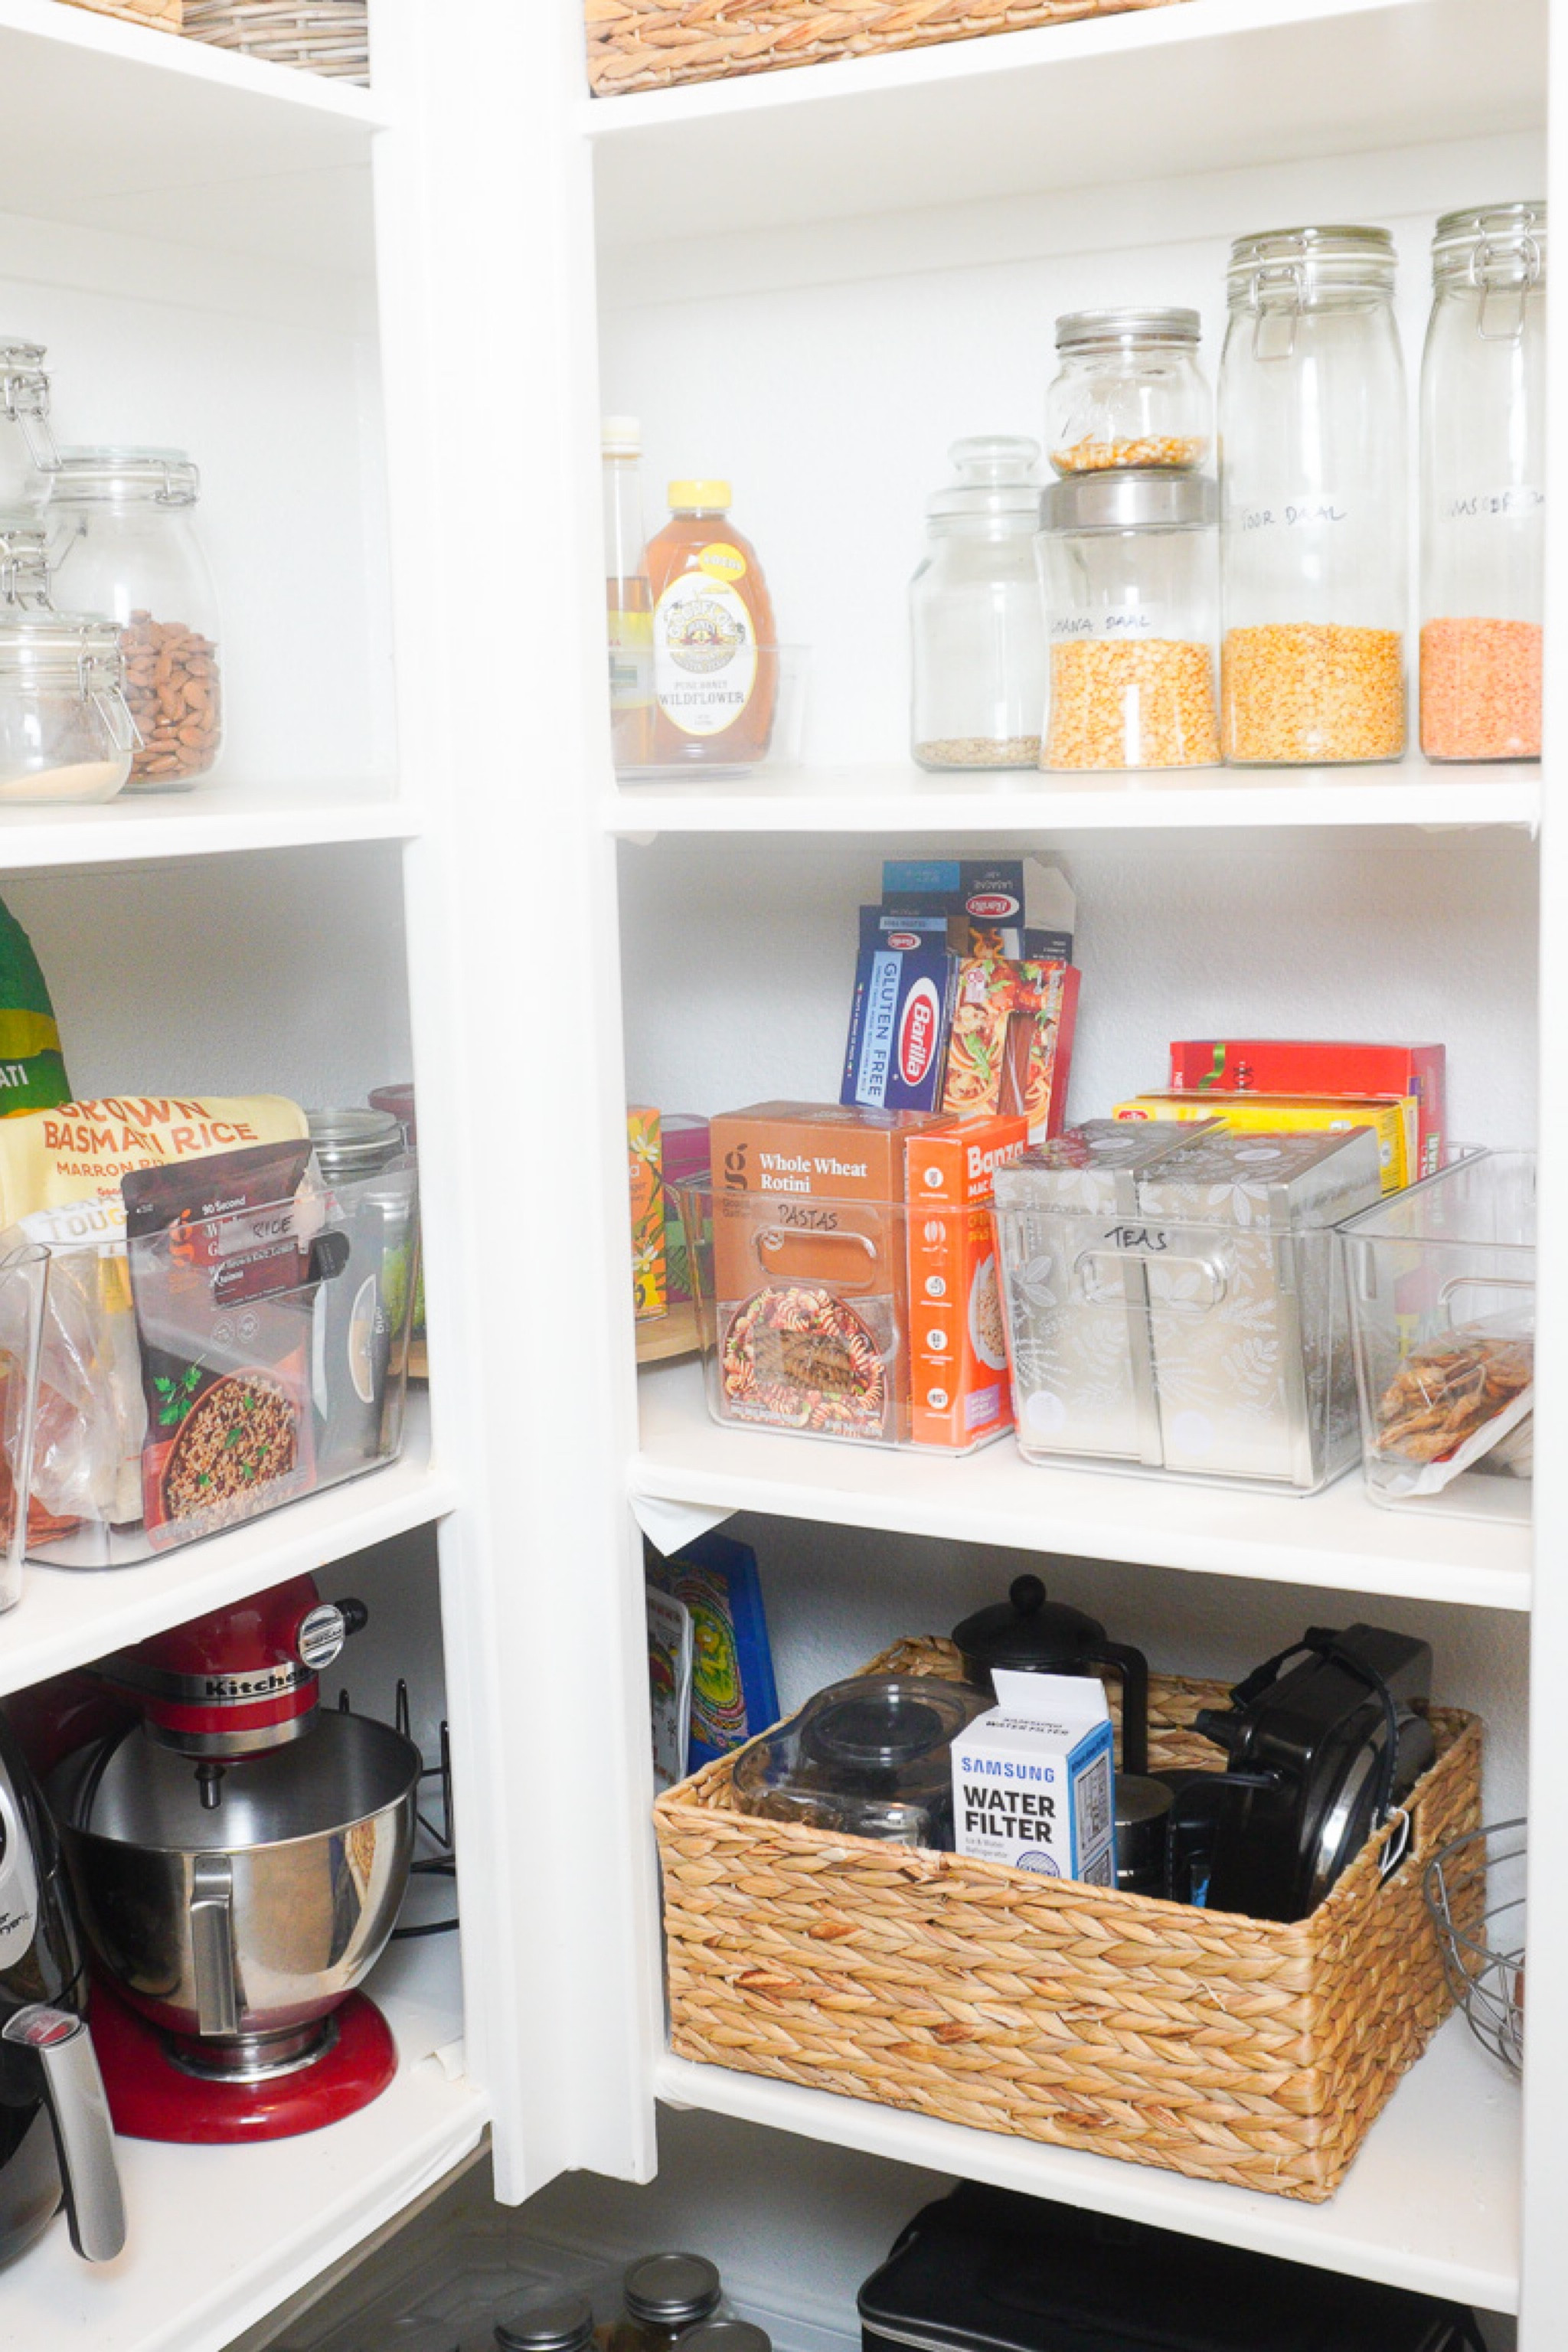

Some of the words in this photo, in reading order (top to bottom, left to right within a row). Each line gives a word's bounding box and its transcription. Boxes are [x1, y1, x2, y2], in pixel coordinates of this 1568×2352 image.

[659, 691, 745, 706] WILDFLOWER
[875, 962, 897, 1040] GLUTEN
[906, 1002, 932, 1077] Barilla
[867, 1050, 888, 1097] FREE
[44, 1120, 165, 1155] BASMATI
[172, 1122, 260, 1155] RICE
[57, 1161, 133, 1178] MARRON
[760, 1153, 812, 1174] Whole
[814, 1158, 867, 1178] Wheat
[968, 1141, 1024, 1179] Banza
[760, 1174, 812, 1194] Rotini
[215, 1194, 247, 1214] Second
[778, 1204, 838, 1230] PASTAS
[48, 1207, 127, 1240] TOUG
[1105, 1226, 1168, 1252] TEAS
[961, 1756, 1055, 1783] SAMSUNG
[963, 1784, 1057, 1818] WATER
[965, 1811, 1053, 1844] FILTER
